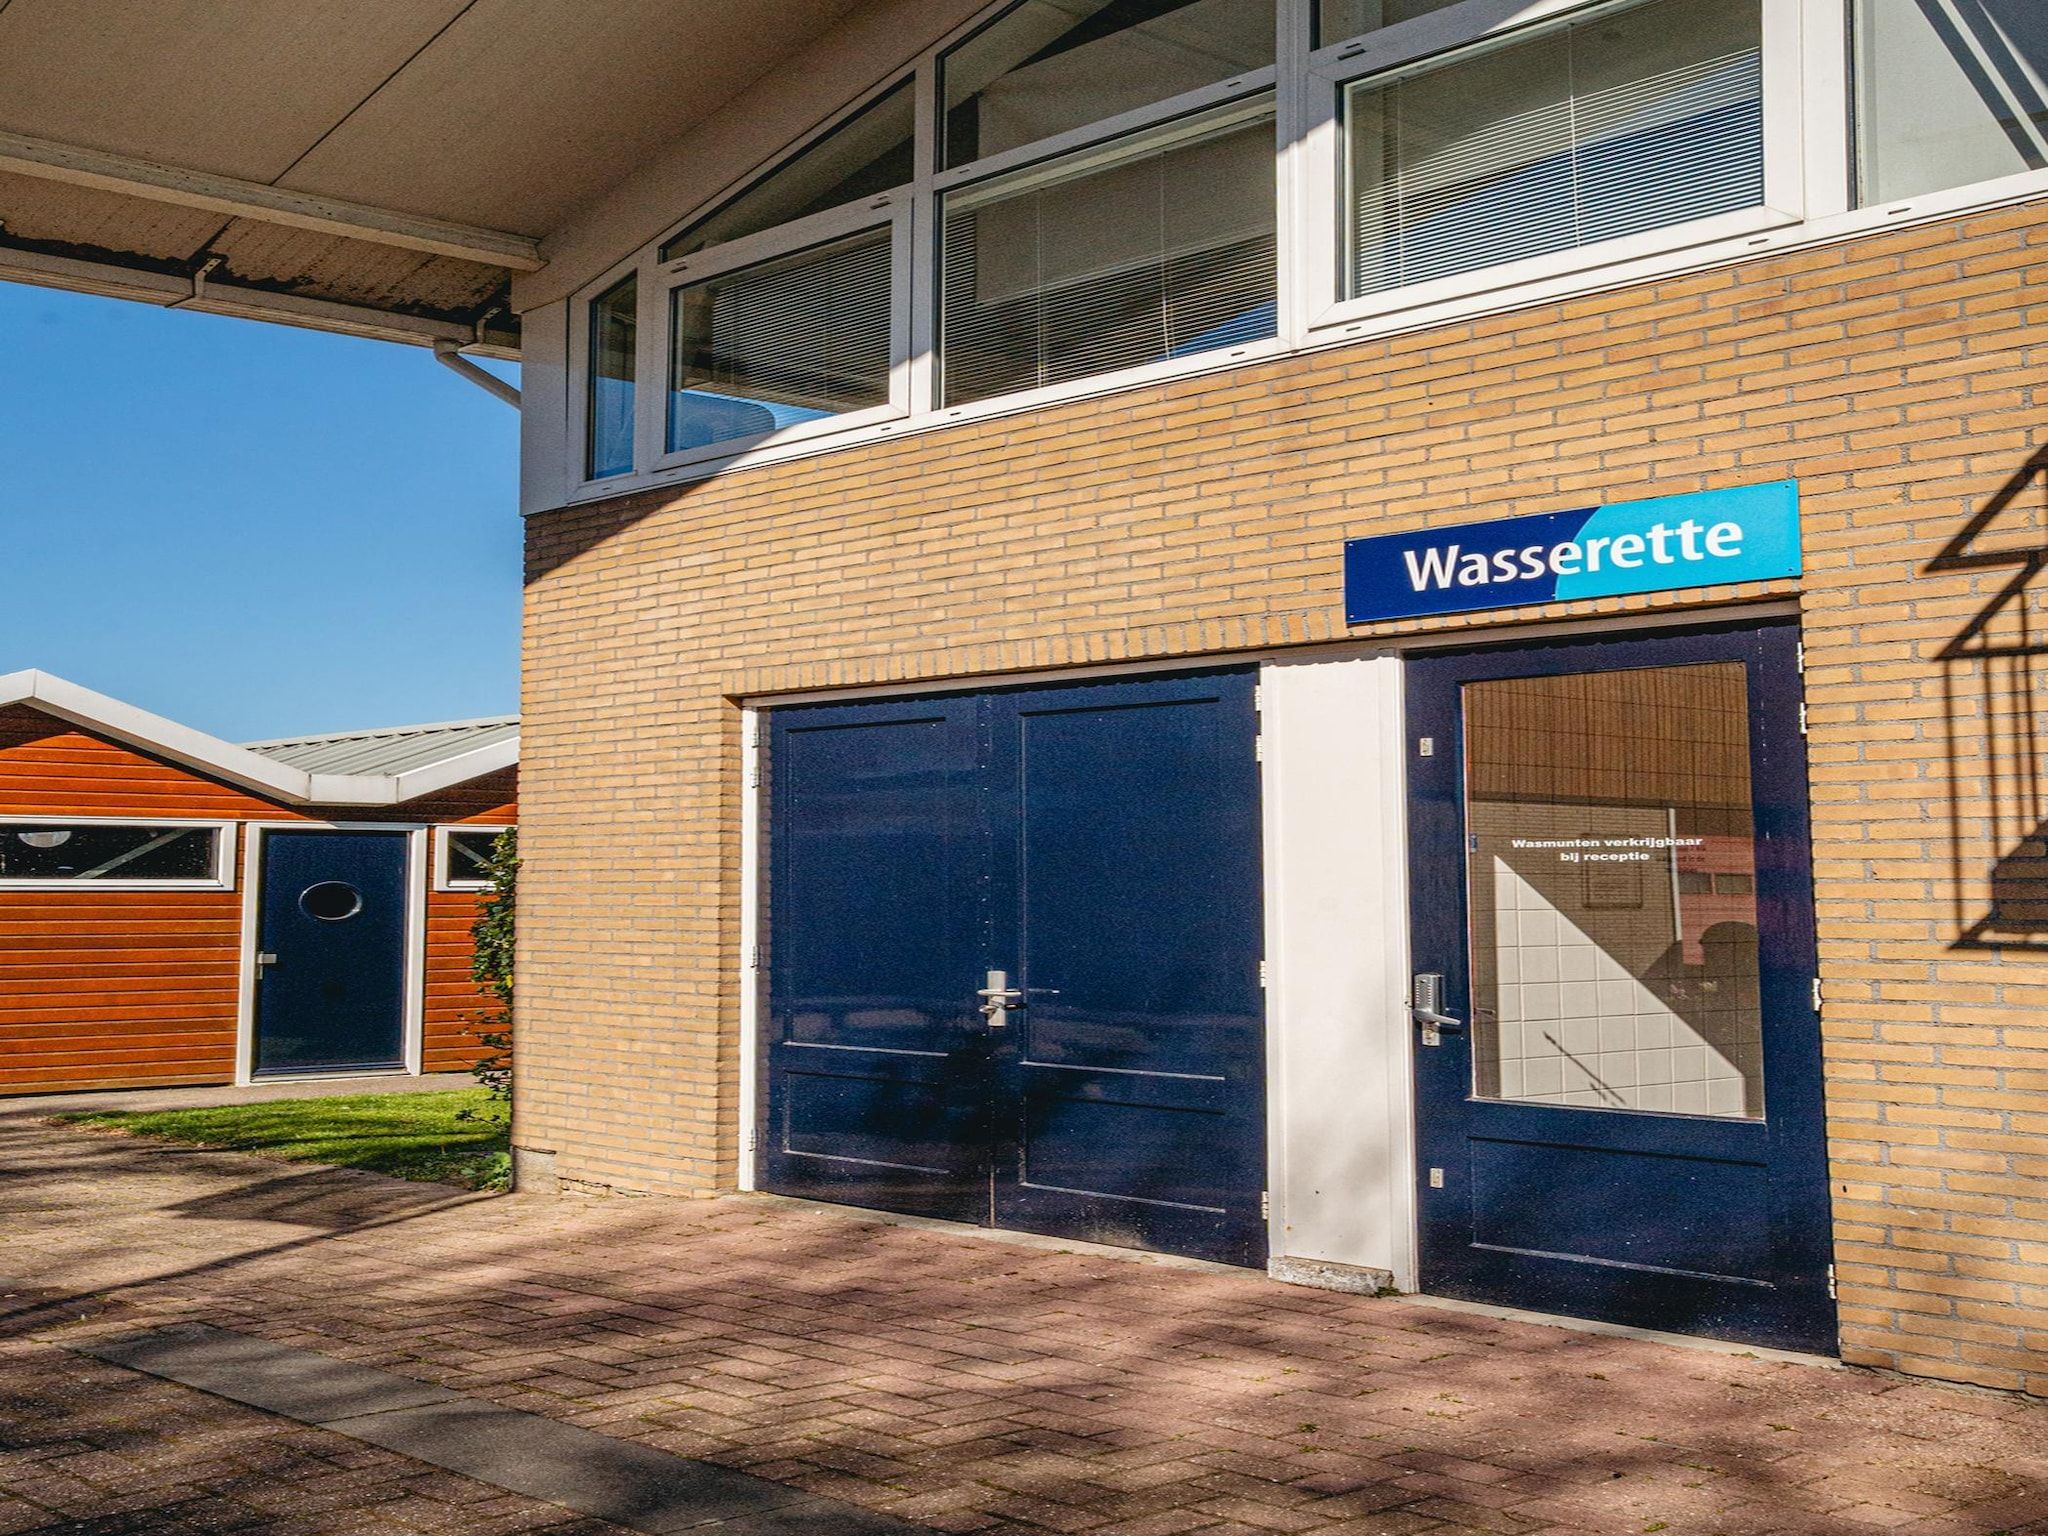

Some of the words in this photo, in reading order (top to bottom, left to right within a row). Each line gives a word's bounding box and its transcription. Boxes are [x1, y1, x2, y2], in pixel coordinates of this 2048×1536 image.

[1403, 518, 1743, 592] Wasserette
[1511, 838, 1600, 848] Wasmunten
[1603, 837, 1704, 848] verkrijgbaar
[1560, 852, 1579, 862] bij
[1584, 851, 1650, 862] receptie
